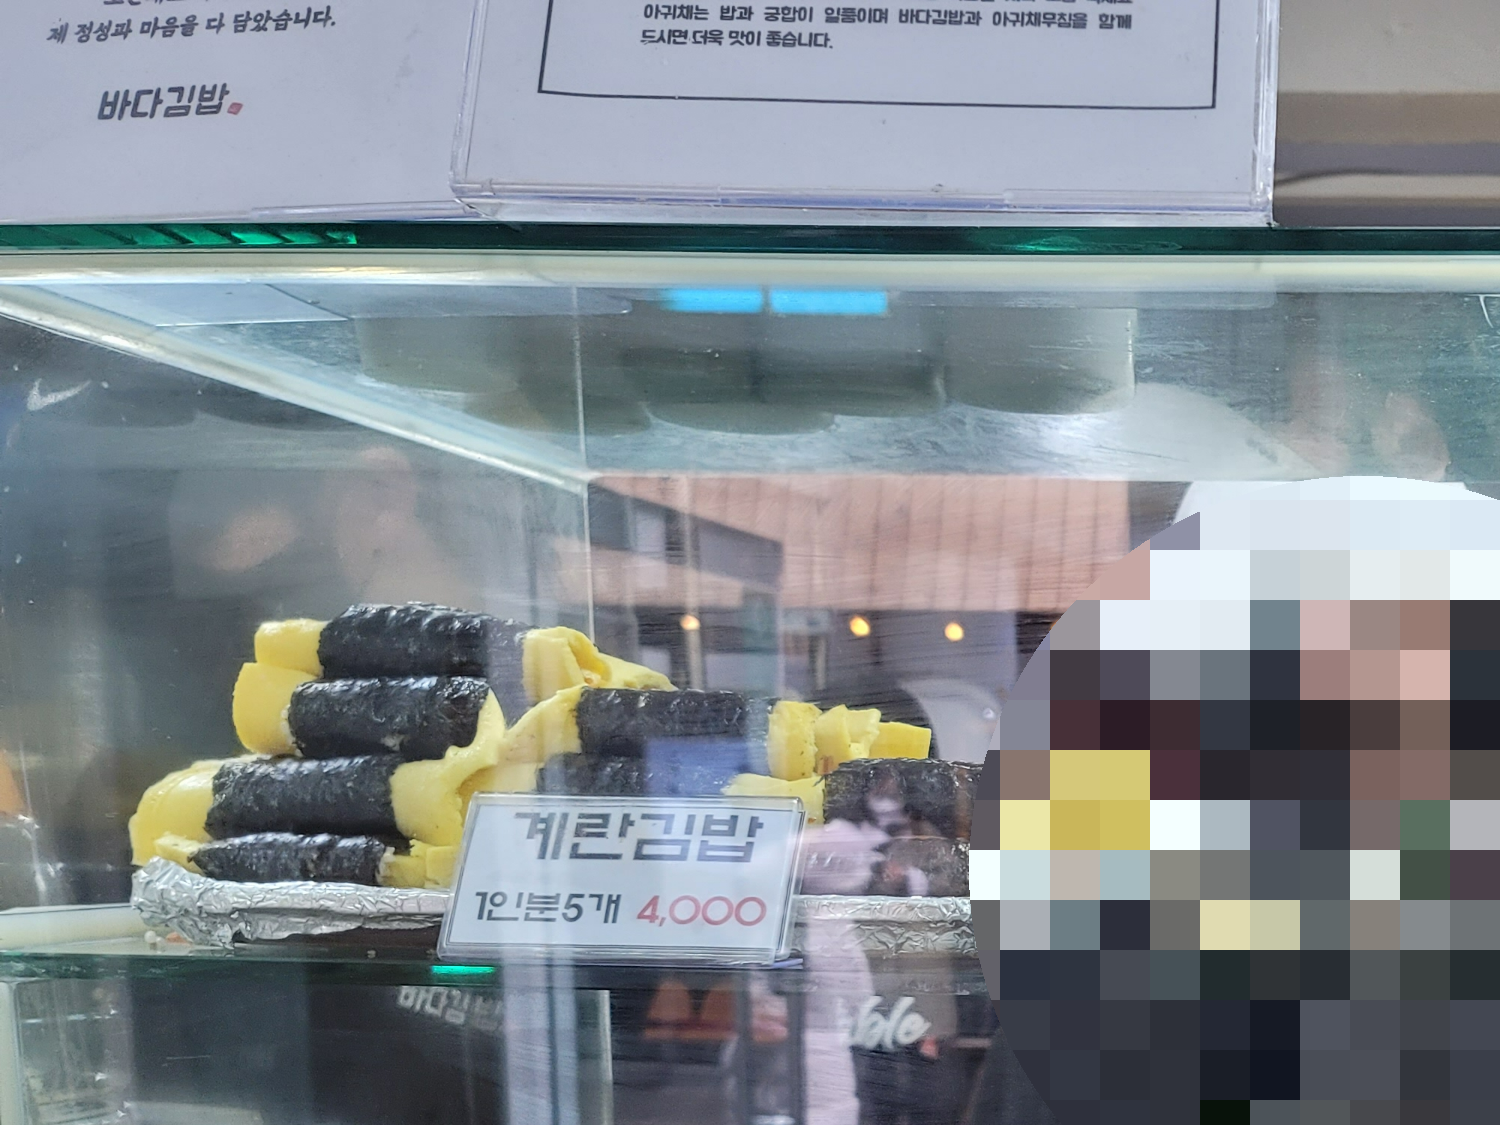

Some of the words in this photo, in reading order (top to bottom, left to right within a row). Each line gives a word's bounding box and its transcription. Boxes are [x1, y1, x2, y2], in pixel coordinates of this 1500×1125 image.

[46, 21, 69, 44] 제
[74, 18, 133, 43] 정성과
[139, 14, 199, 39] 마음을
[205, 12, 226, 34] 다
[232, 5, 337, 34] 담았습니다.
[642, 4, 710, 21] 아귀채는
[719, 5, 755, 22] 밥과
[763, 6, 814, 23] 궁합이
[824, 7, 889, 24] 일품이며
[898, 8, 983, 27] 바다김밥과
[992, 11, 1088, 30] 아귀채무침을
[1098, 13, 1133, 30] 함께
[641, 28, 689, 46] 드시면
[691, 29, 725, 46] 더욱
[728, 30, 762, 47] 맛이
[765, 30, 834, 49] 좋습니다.
[97, 82, 231, 121] 바다김밥
[514, 811, 765, 863] 계란김밥
[636, 894, 768, 928] 4,000
